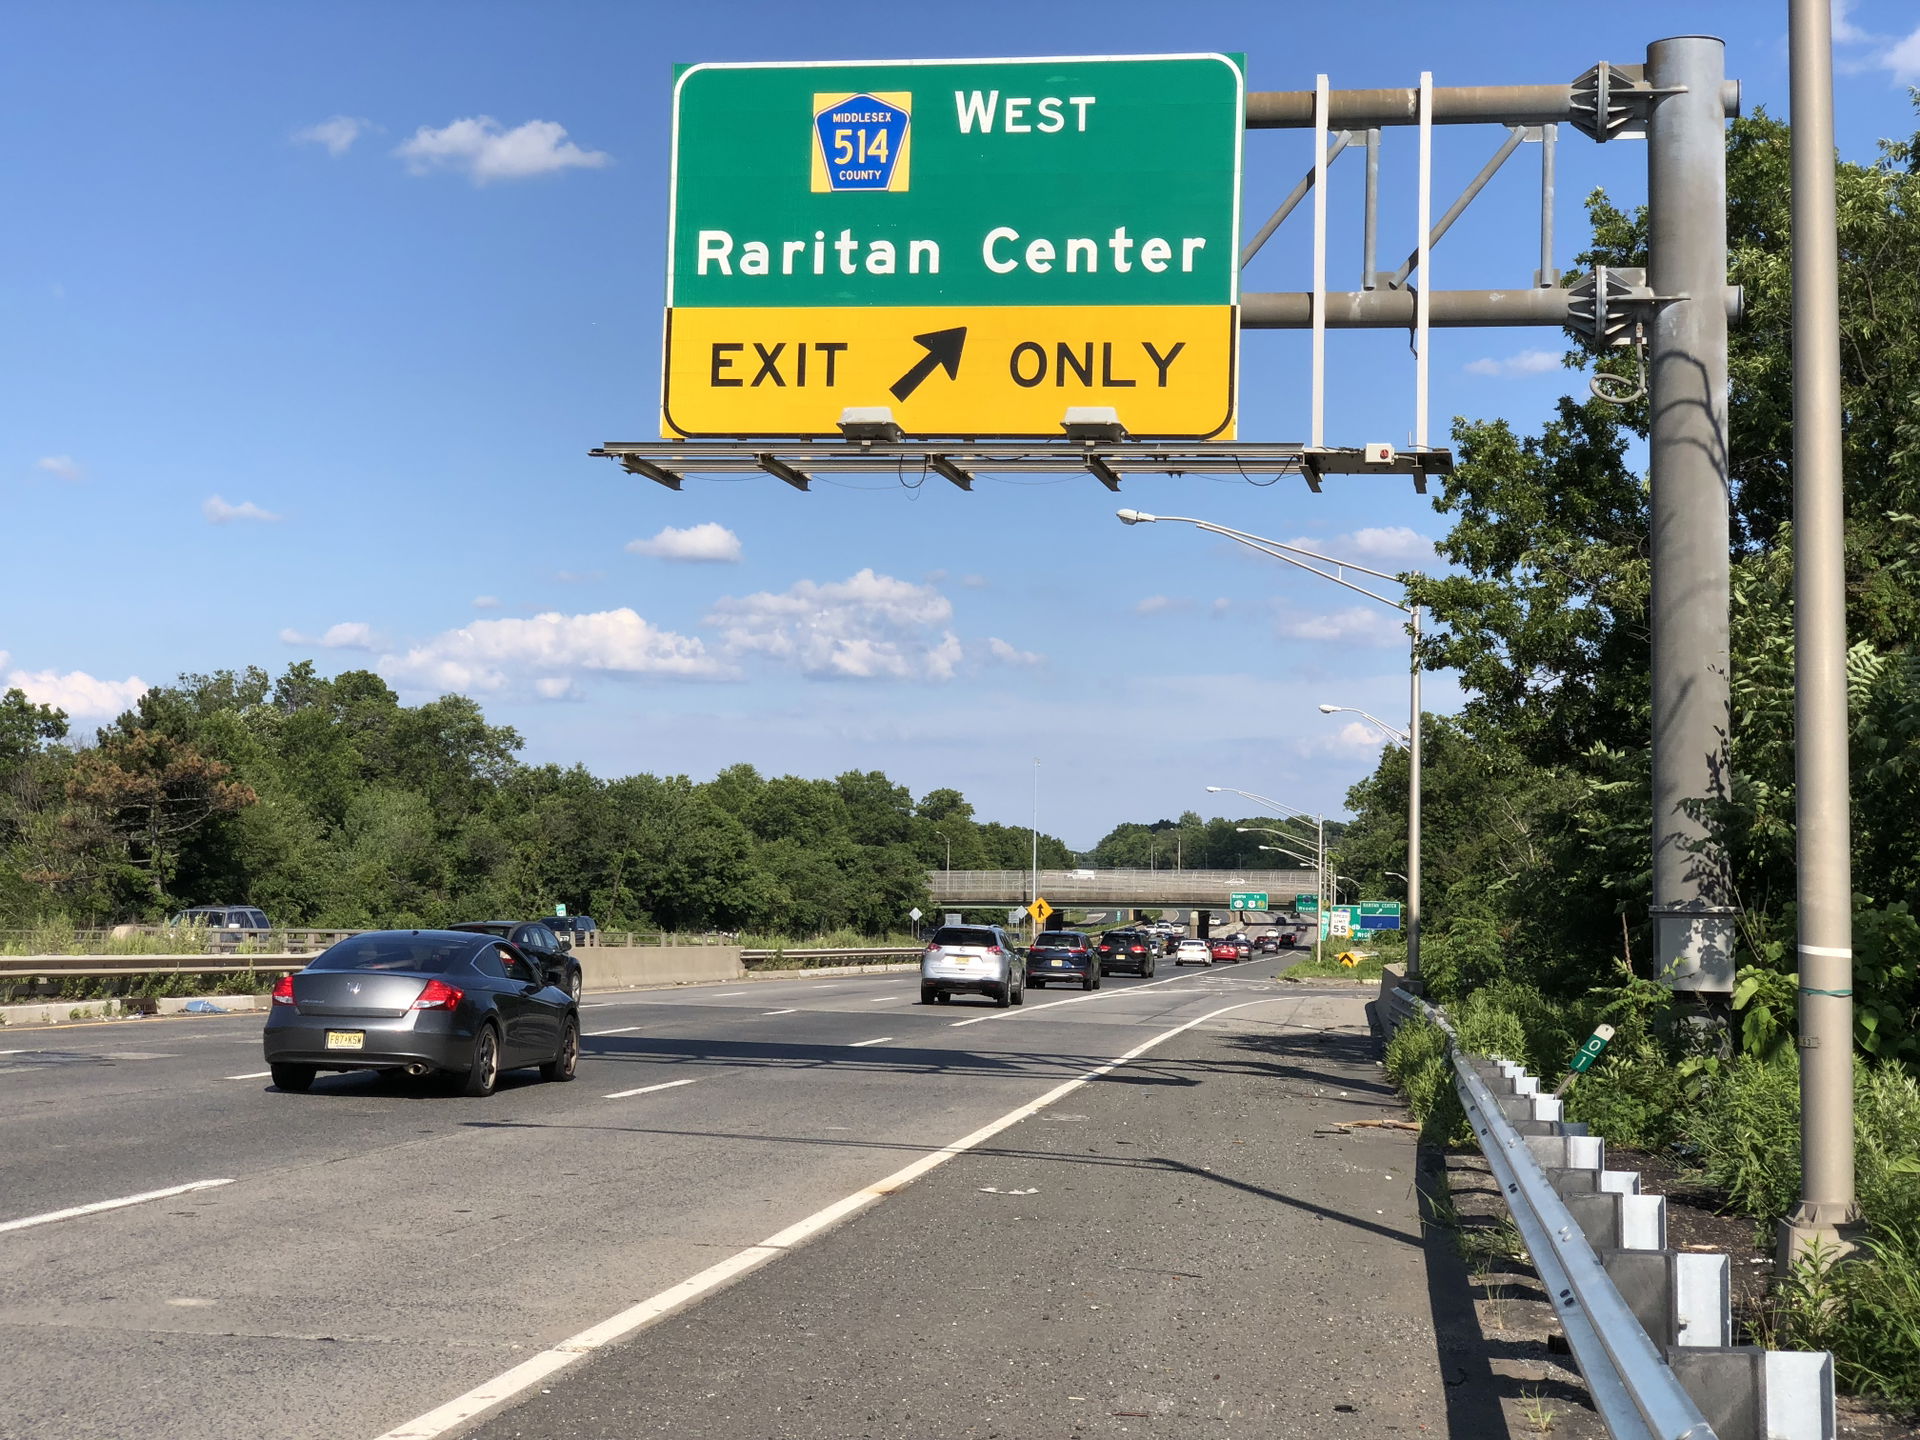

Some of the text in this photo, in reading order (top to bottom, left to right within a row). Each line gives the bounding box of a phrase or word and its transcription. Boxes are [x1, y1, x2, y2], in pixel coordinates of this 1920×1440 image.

[832, 111, 893, 124] MIDDLESEX
[954, 89, 1097, 134] WEST
[833, 128, 890, 166] 514
[838, 169, 882, 182] COUNTY
[696, 225, 1208, 276] Raritan Center
[710, 341, 1187, 388] EXIT ONLY
[1333, 924, 1347, 933] 55
